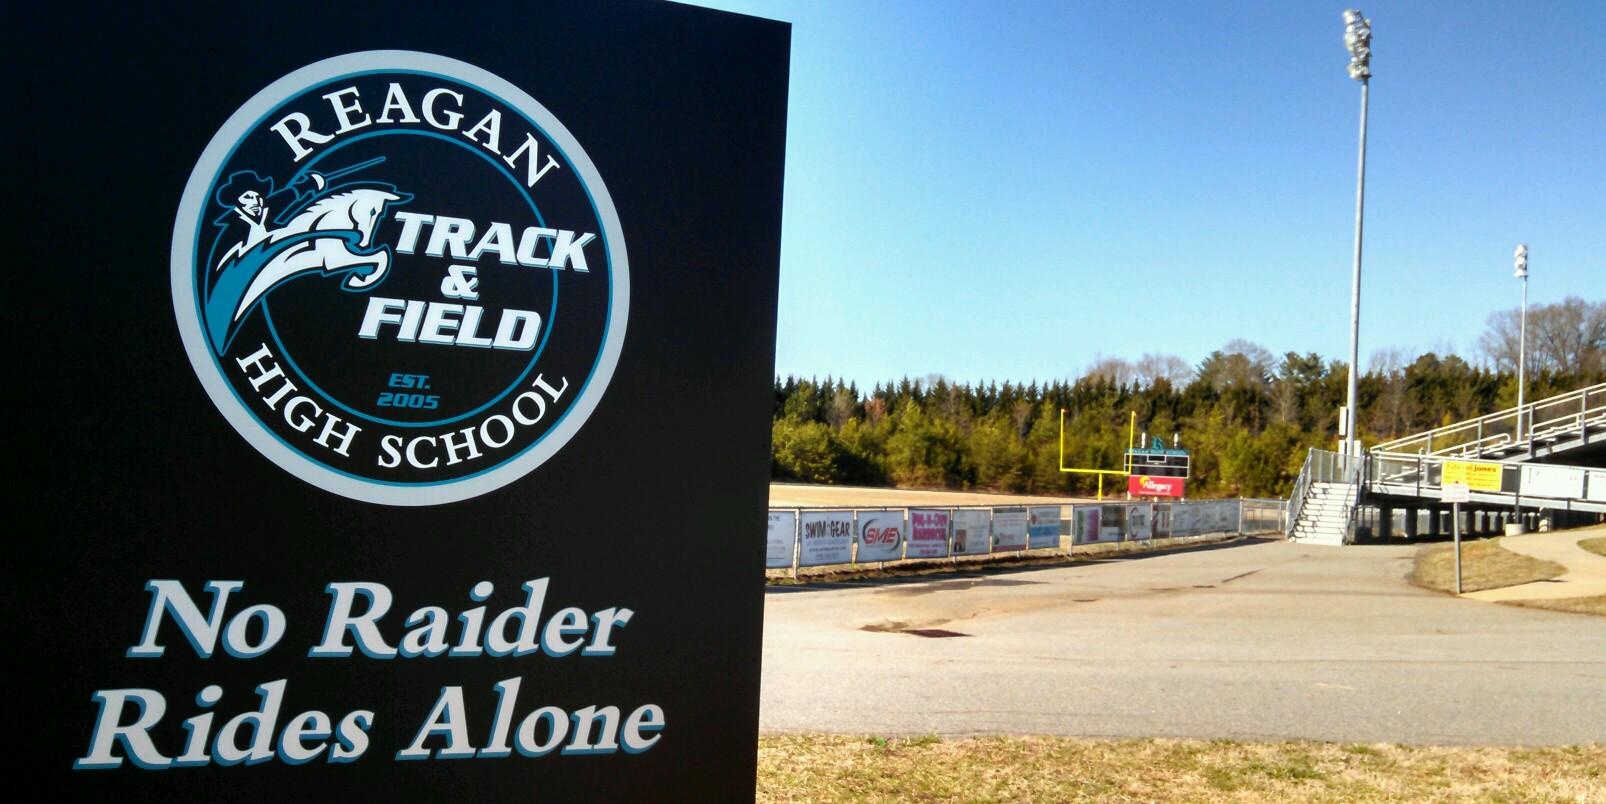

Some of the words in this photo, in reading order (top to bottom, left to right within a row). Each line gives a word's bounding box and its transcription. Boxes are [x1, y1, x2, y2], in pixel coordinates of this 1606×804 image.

[270, 82, 560, 188] REAGAN
[394, 211, 597, 273] TRACK
[440, 264, 479, 300] &
[358, 296, 542, 351] FIELD
[235, 343, 362, 457] HIGH
[378, 373, 569, 468] SCHOOL
[376, 392, 440, 410] 2005
[388, 373, 431, 389] EST.
[805, 520, 826, 539] SWIM
[830, 520, 850, 538] GEAR
[864, 527, 898, 545] SME
[126, 579, 287, 659] No
[307, 577, 635, 660] Raider
[73, 679, 375, 769] Rides
[395, 676, 666, 761] Alone
